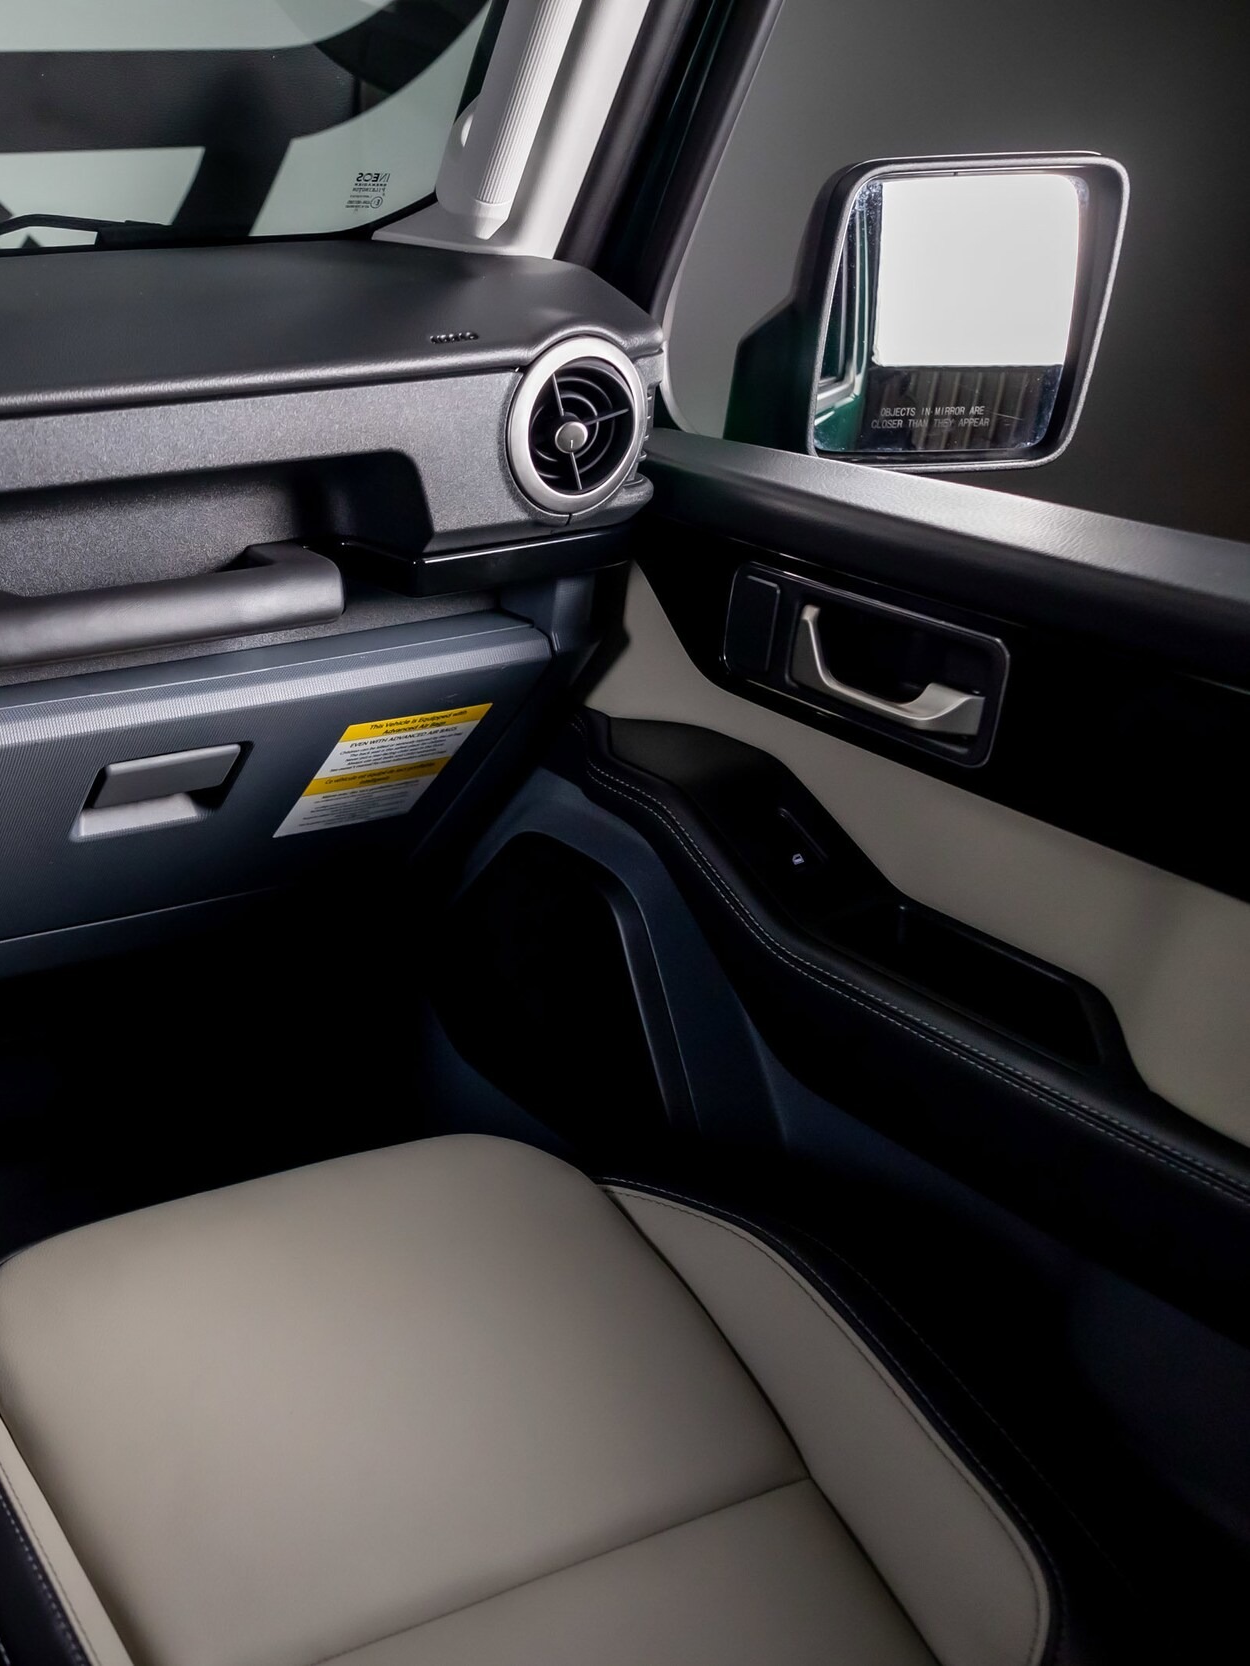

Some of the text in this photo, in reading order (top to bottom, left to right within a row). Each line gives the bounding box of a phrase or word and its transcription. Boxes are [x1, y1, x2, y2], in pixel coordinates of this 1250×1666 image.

[880, 406, 985, 417] OBJECTS IN MIRROR ARE
[871, 417, 990, 429] CLOSER THAN THEY APPEAR
[350, 740, 368, 748] EVEN
[369, 737, 388, 745] WITH
[389, 731, 427, 742] ADVANCED
